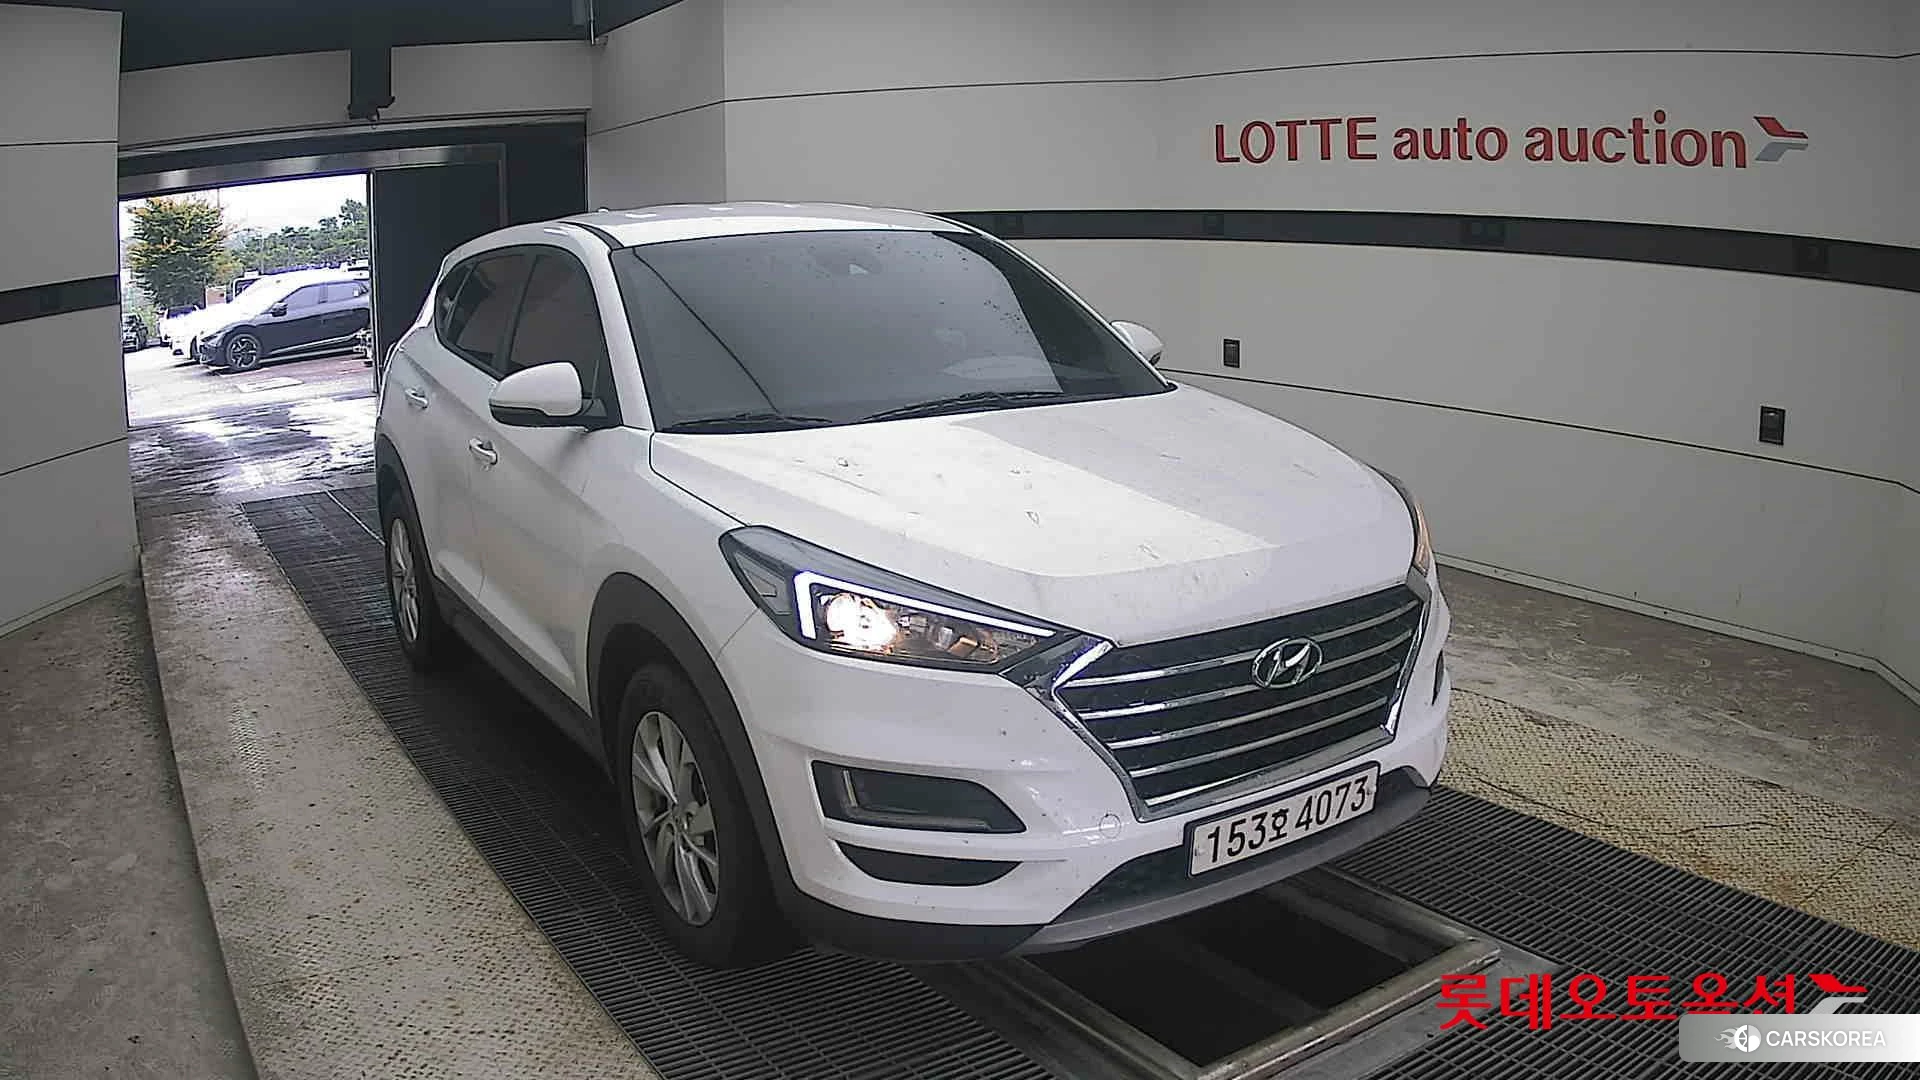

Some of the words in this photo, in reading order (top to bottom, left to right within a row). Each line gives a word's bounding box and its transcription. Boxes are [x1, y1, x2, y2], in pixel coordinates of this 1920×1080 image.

[1215, 117, 1377, 163] LOTTE
[1392, 118, 1509, 161] auto
[1524, 109, 1747, 168] auction
[1295, 775, 1369, 831] 4073
